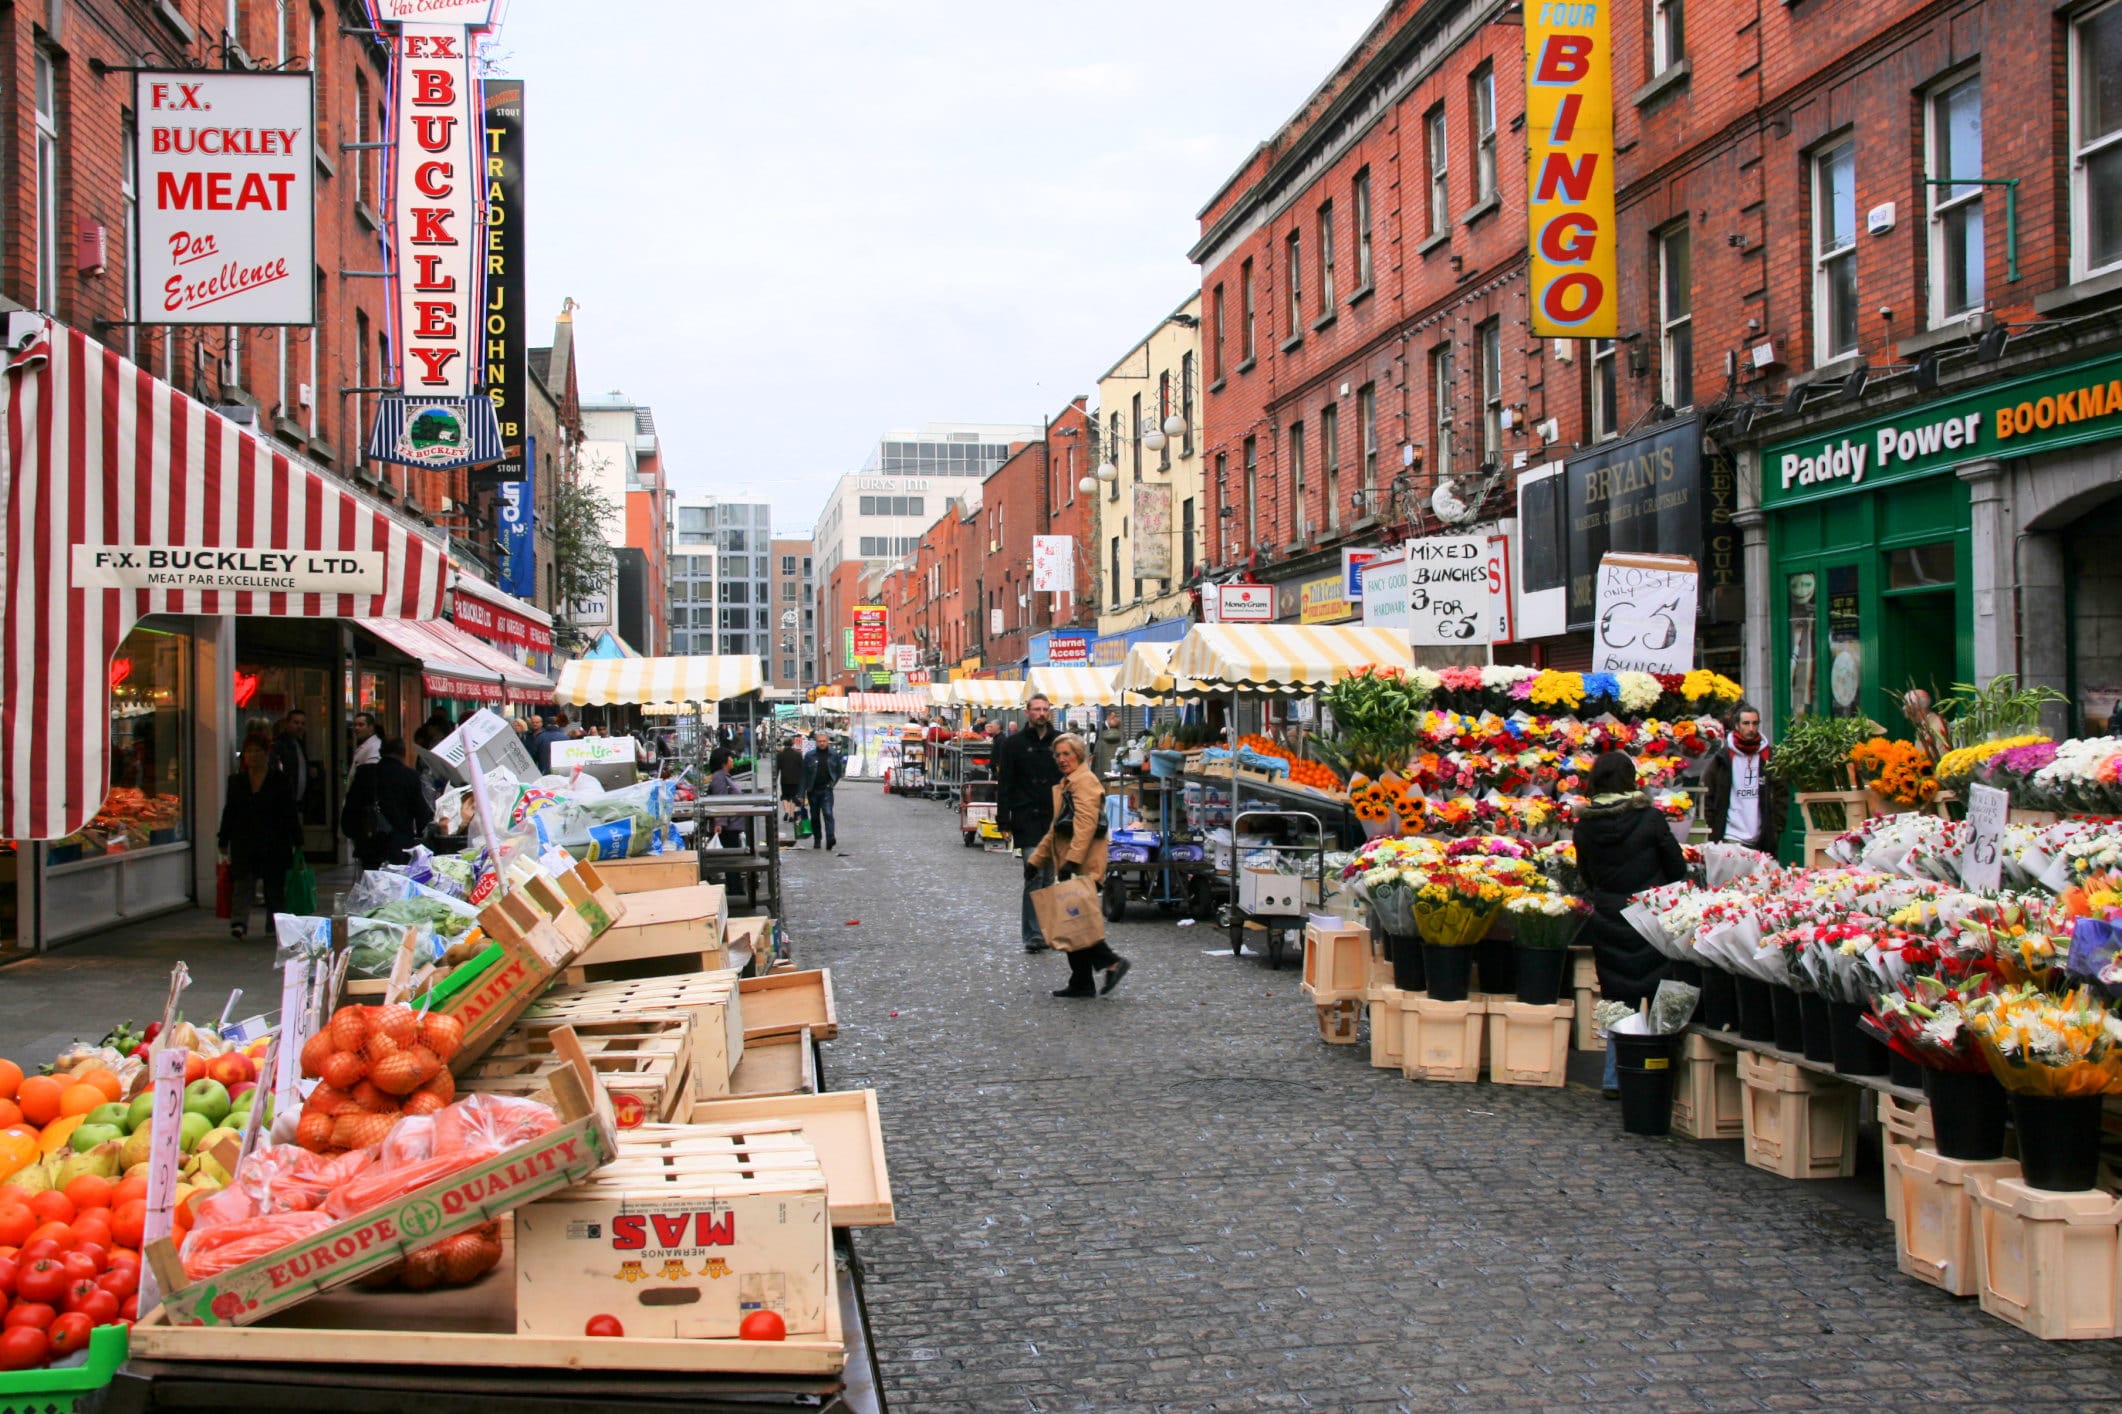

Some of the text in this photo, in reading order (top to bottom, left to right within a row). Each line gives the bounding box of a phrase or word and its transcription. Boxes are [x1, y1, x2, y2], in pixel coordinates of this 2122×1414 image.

[1539, 3, 1597, 27] FOUR
[404, 36, 463, 59] F.X.
[150, 82, 212, 111] F.X.
[496, 108, 521, 116] STOUT
[151, 126, 301, 156] BUCKLEY
[157, 171, 295, 211] MEAT
[1531, 34, 1604, 327] BINGO
[486, 128, 506, 275] TRADER
[410, 69, 458, 385] BUCKLEY
[168, 230, 217, 266] Par
[163, 257, 287, 311] Excellence
[487, 286, 506, 408] JOHNS
[416, 447, 465, 458] BUCKLEY
[1781, 439, 1868, 489] Paddy
[1876, 411, 1982, 466] Power
[497, 464, 521, 473] STOUT
[1584, 446, 1674, 504] BRYAN'S
[856, 476, 896, 490] JURYS
[1711, 458, 1733, 585] KEYS CUT
[96, 550, 364, 574] F.X. BUCKLEY LTD.
[1412, 566, 1487, 585] BUNCHES
[148, 572, 296, 588] MEAT PAR EXCELLENCE
[1603, 587, 1634, 598] ONLY
[1411, 588, 1464, 615] 3 FOR
[1438, 612, 1478, 639] €5
[1049, 638, 1086, 648] Internet
[1050, 649, 1086, 658] Access
[267, 1218, 397, 1289] EUROPE
[440, 1138, 579, 1214] QUALITY
[612, 1211, 735, 1250] MAS
[640, 1247, 706, 1259] HERMANOS
